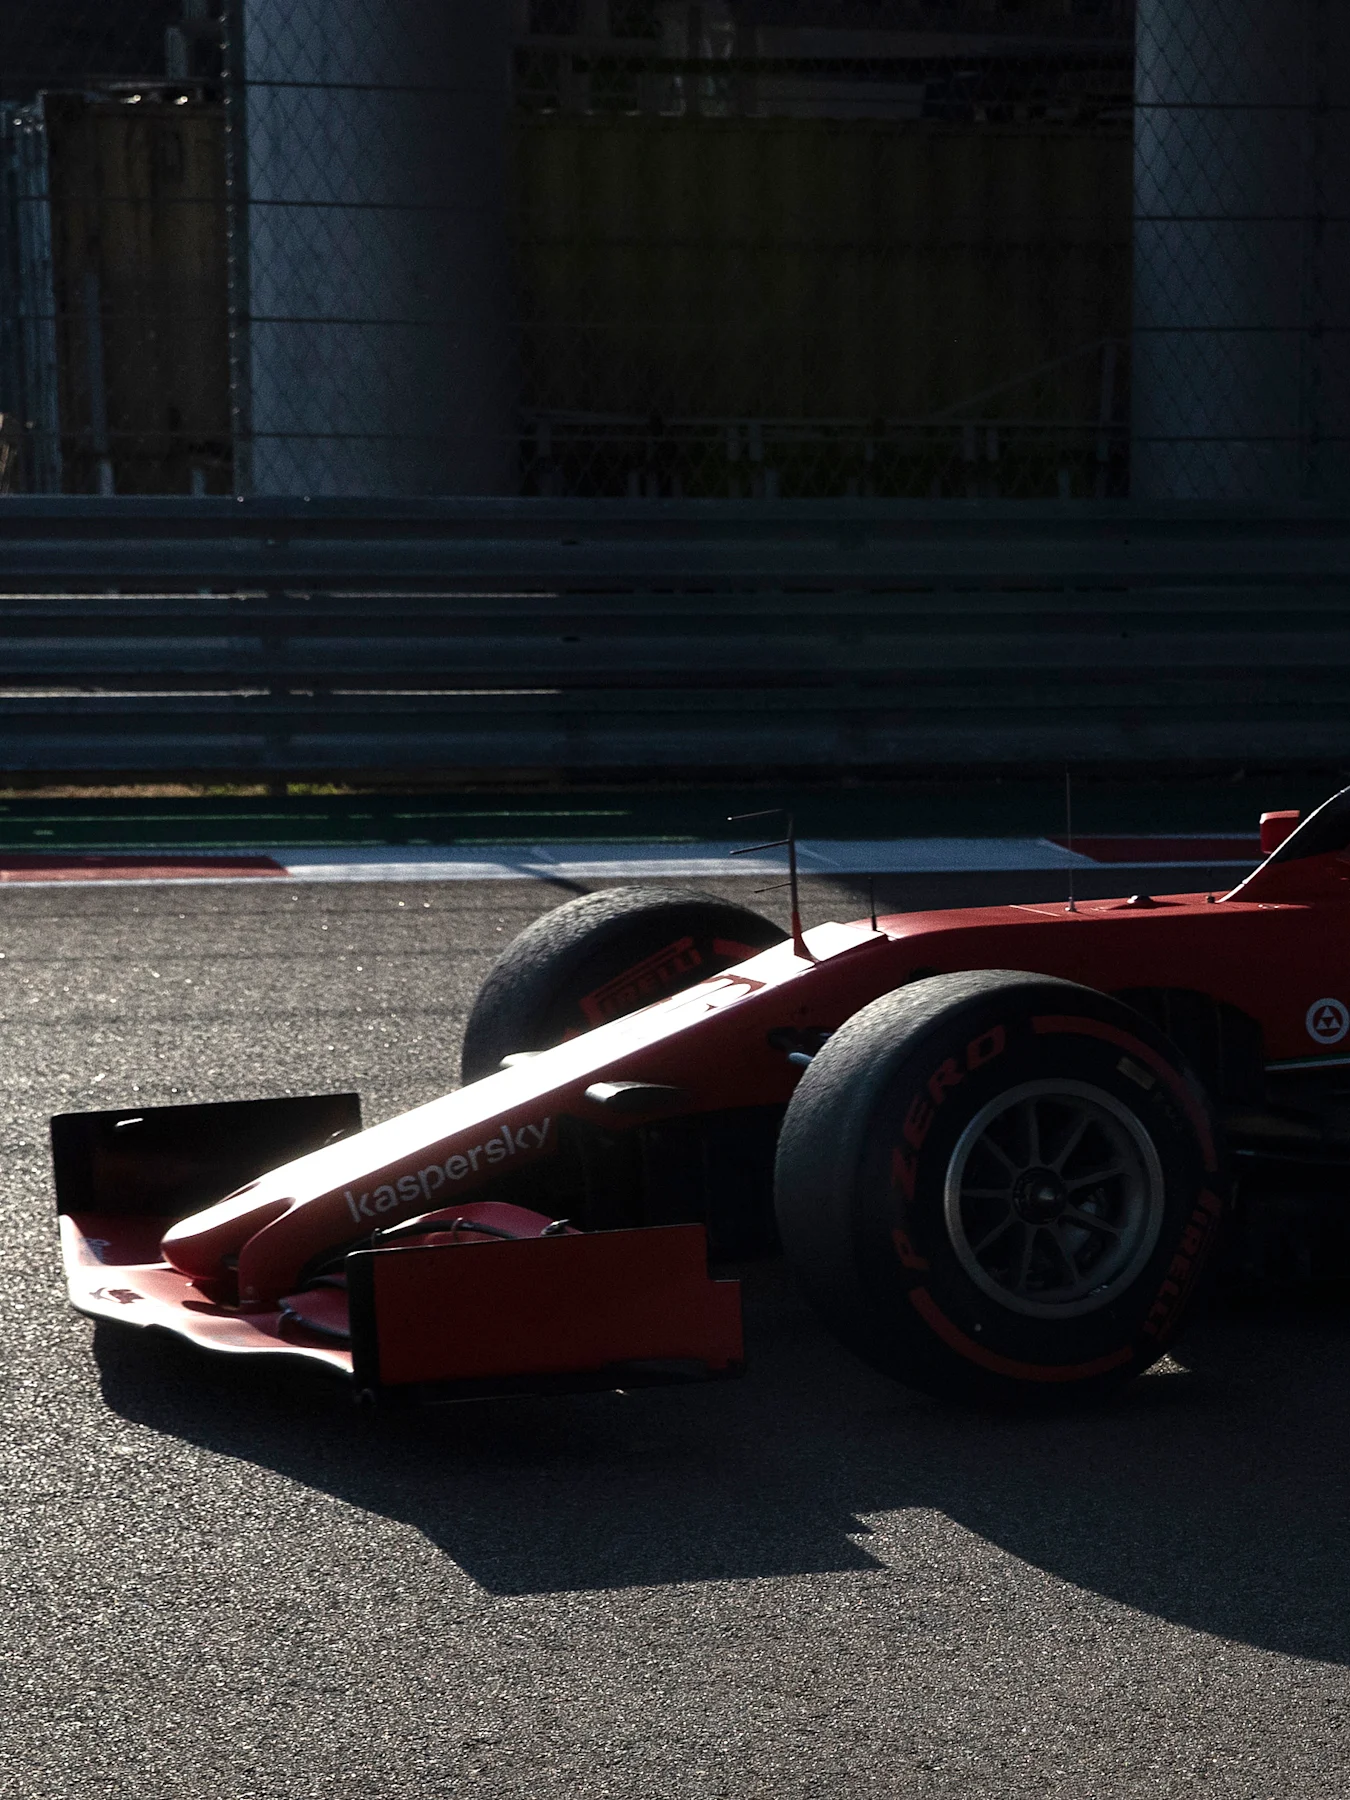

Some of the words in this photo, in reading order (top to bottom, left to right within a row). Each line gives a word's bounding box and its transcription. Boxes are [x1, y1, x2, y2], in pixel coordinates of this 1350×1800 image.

[345, 1116, 554, 1223] kaspersky
[891, 1025, 1007, 1201] ZERO
[1142, 1187, 1223, 1343] PIRELLI
